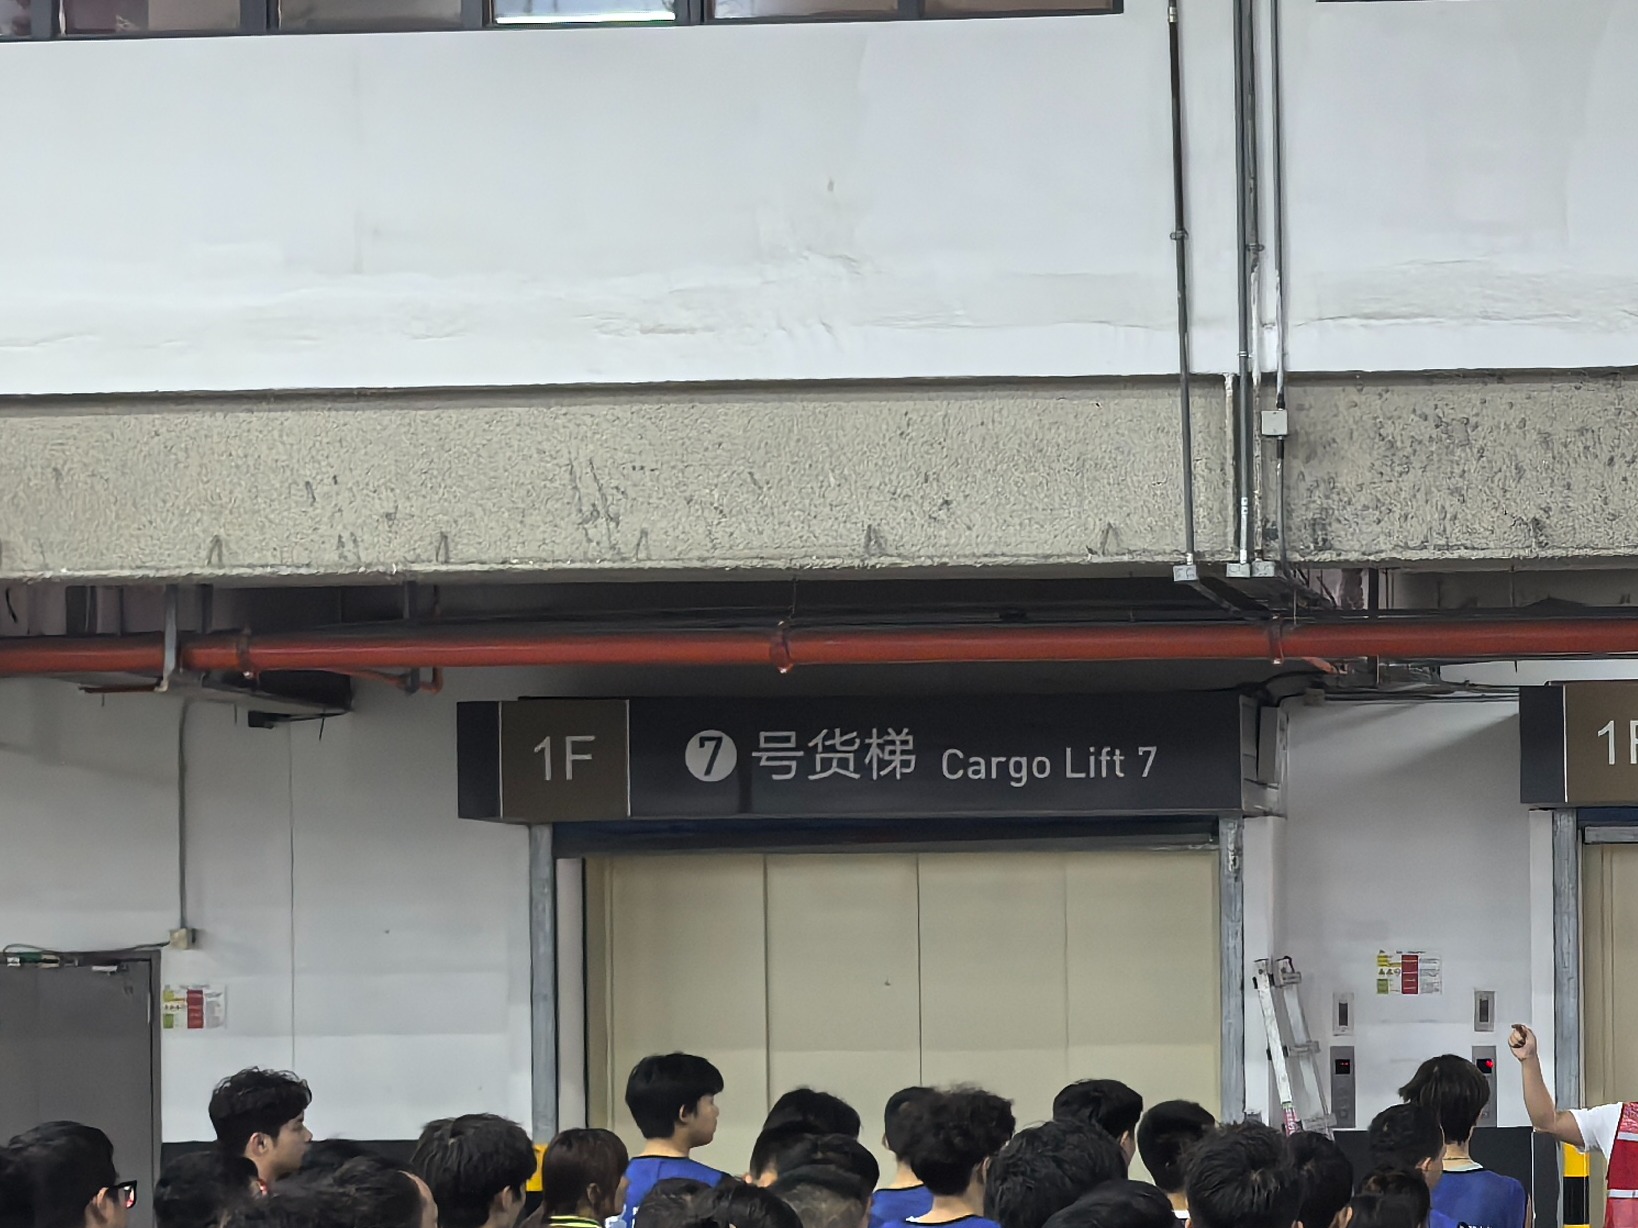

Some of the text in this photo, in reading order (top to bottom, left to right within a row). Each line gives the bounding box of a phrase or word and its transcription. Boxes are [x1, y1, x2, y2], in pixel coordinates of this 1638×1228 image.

[532, 734, 596, 781] 1F
[751, 728, 917, 781] 号货梯
[940, 746, 1051, 787] Cargo
[1065, 743, 1125, 778] Lift
[1137, 744, 1158, 778] 7
